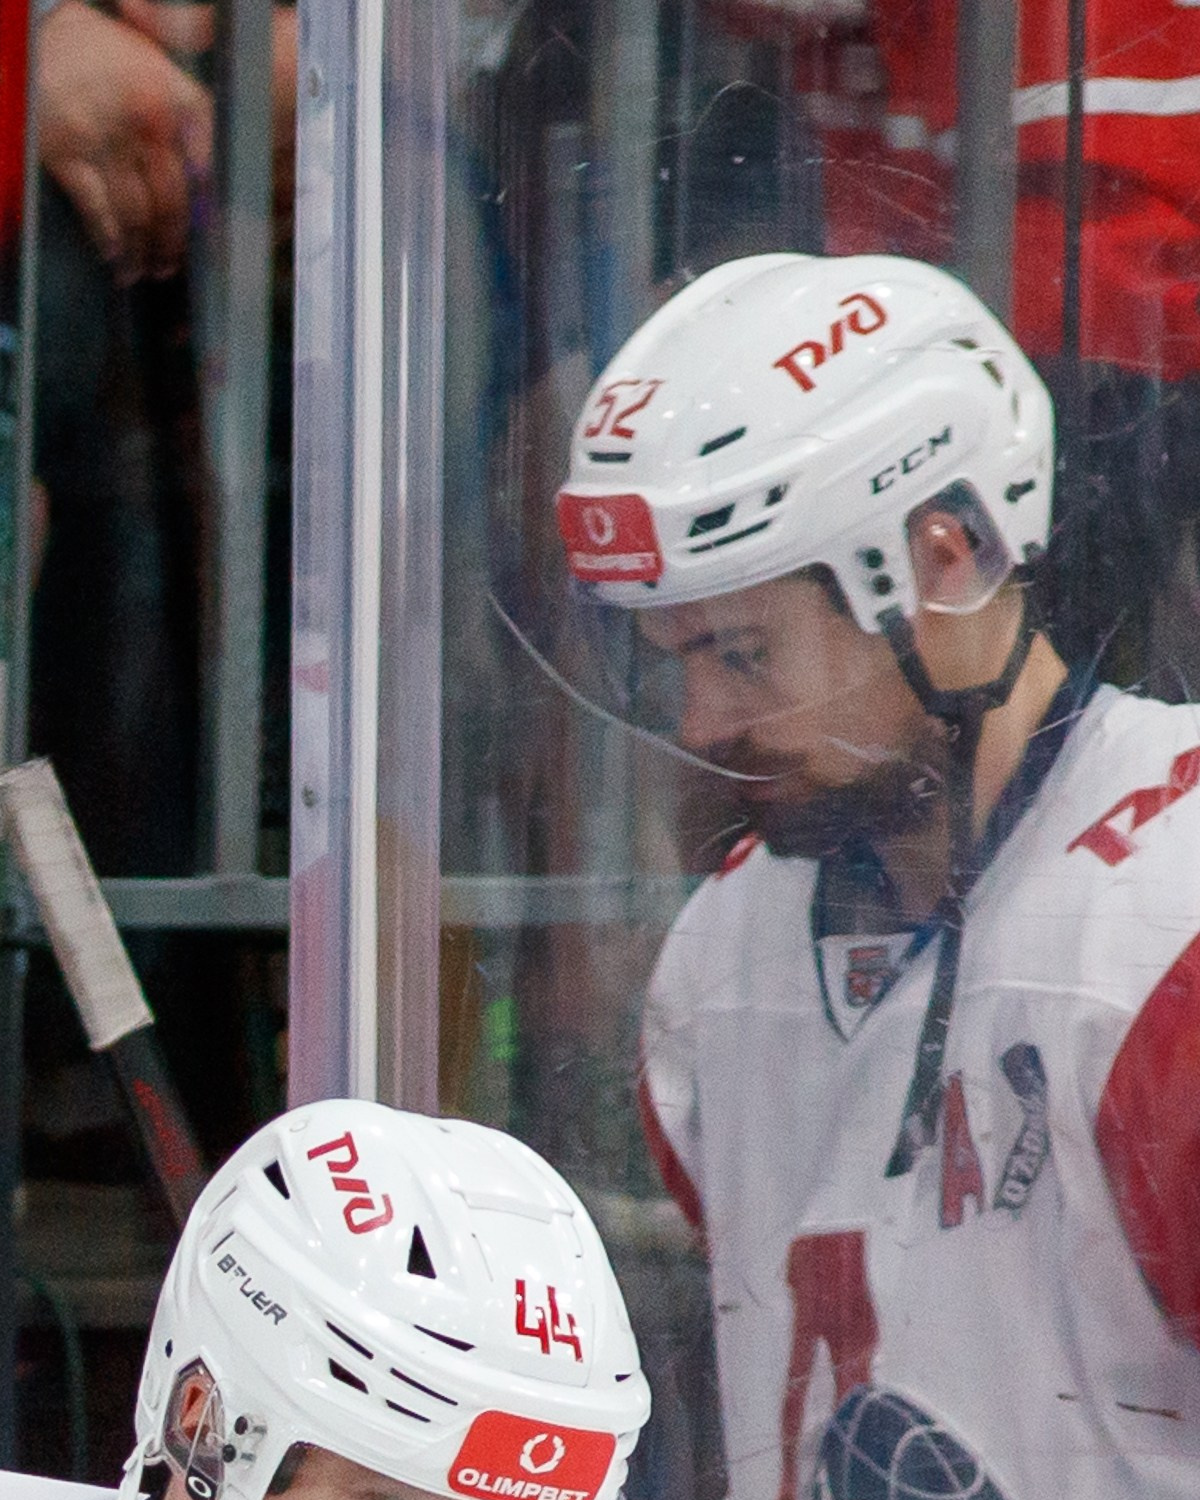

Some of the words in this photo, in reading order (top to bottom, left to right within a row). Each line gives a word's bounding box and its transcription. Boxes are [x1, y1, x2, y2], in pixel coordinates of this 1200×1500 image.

[584, 378, 666, 439] 52
[869, 424, 954, 495] CCM
[514, 1278, 584, 1363] 44
